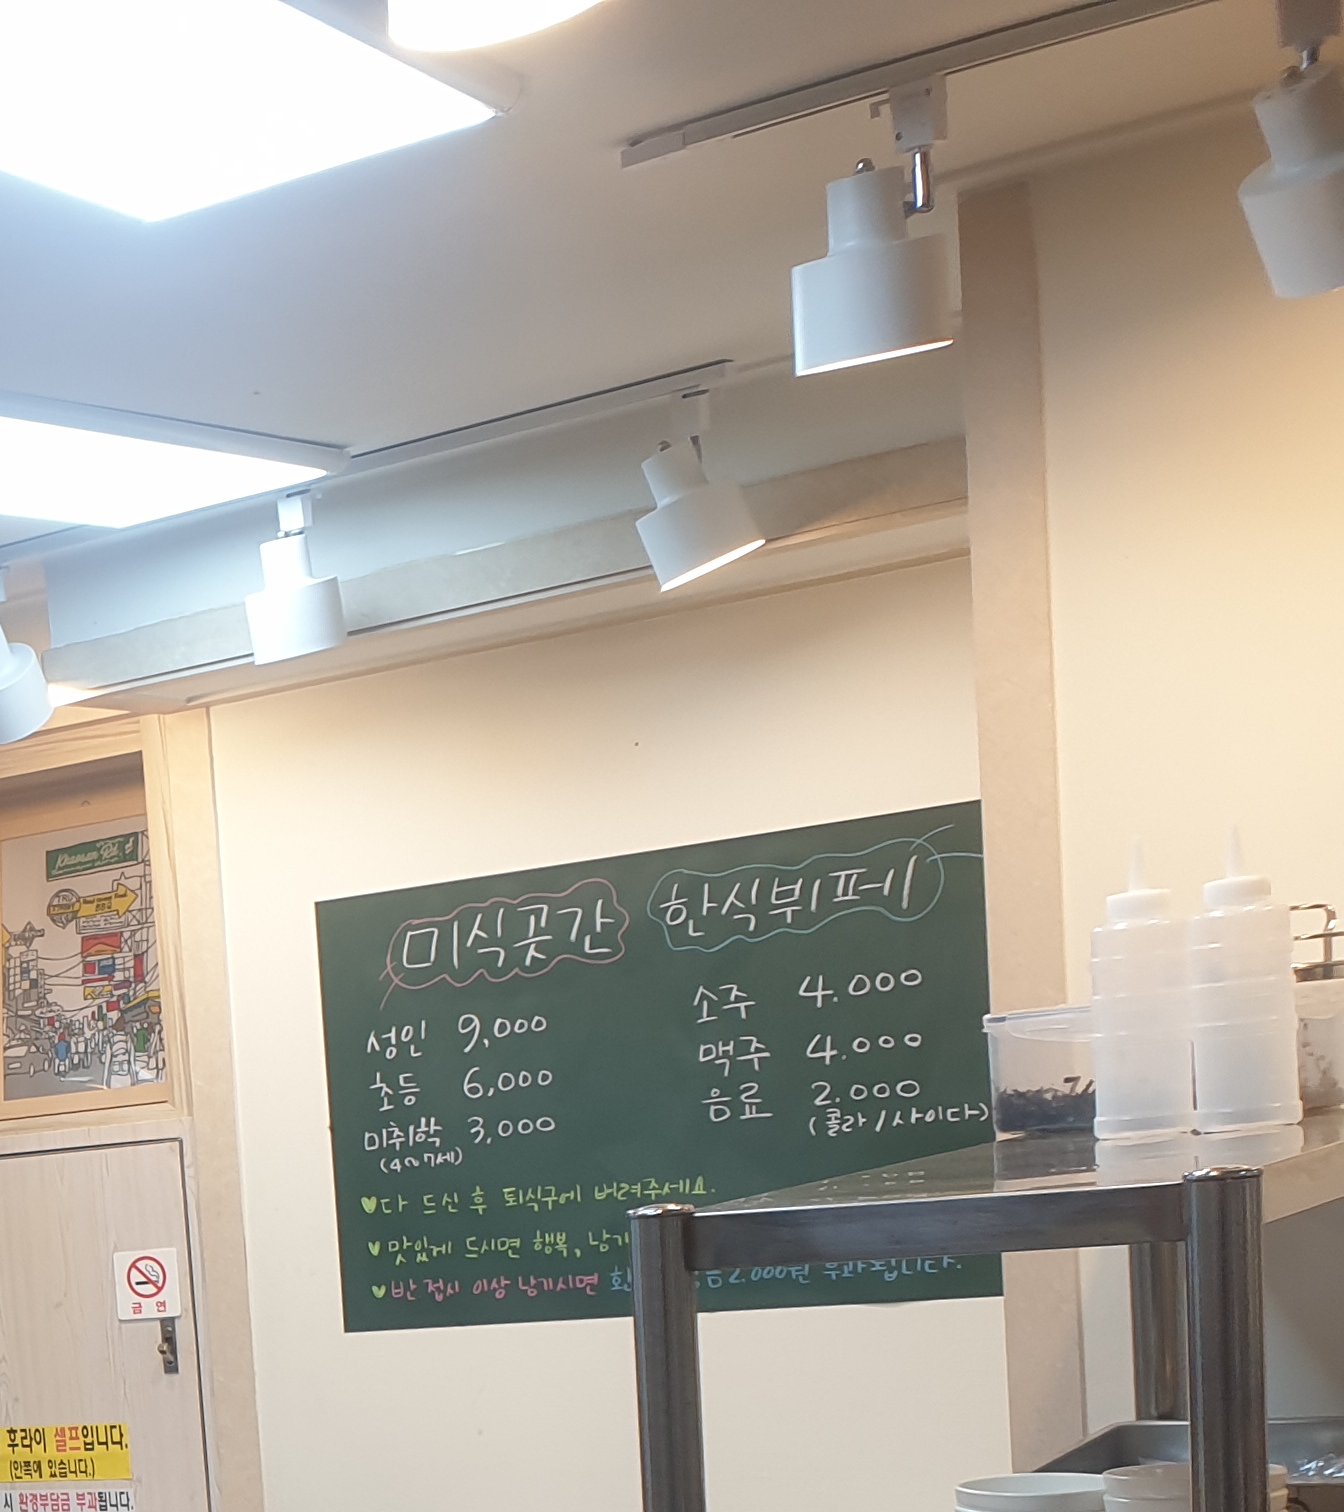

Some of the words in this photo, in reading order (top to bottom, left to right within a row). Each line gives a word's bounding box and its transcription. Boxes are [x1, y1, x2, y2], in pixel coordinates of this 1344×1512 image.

[402, 898, 616, 970] 미식곳간
[659, 854, 919, 937] 한식뷔페
[693, 984, 757, 1024] 소주
[798, 969, 923, 1009] 4.000
[366, 1019, 427, 1060] 성인
[457, 1013, 548, 1054] 9,000
[698, 1036, 772, 1077] 맥주
[805, 1033, 923, 1066] 4.000
[368, 1071, 422, 1112] 초등
[463, 1066, 554, 1099] 6,000
[701, 1082, 774, 1122] 음료
[811, 1079, 921, 1106] 2.000
[364, 1116, 443, 1151] 미취학
[467, 1116, 556, 1144] 3,000
[380, 1194, 409, 1214] 다
[423, 1192, 460, 1214] 드신
[469, 1185, 488, 1215] 후
[502, 1184, 582, 1213] 퇴식구에
[388, 1235, 452, 1266] 맛있게
[464, 1236, 522, 1259] 드시면
[390, 1280, 417, 1301] 반
[423, 1279, 460, 1302] 접시
[472, 1275, 512, 1299] 이상
[518, 1272, 600, 1297] 남기시면
[6, 1427, 47, 1455] 후라이
[54, 1424, 129, 1453] 셀프입니다.
[9, 1459, 43, 1480] (안쪽에
[47, 1457, 96, 1479] 있습니다.)
[3, 1492, 14, 1512] 시
[18, 1491, 71, 1512] 환경부담금
[76, 1491, 134, 1512] 부과됩니다.
